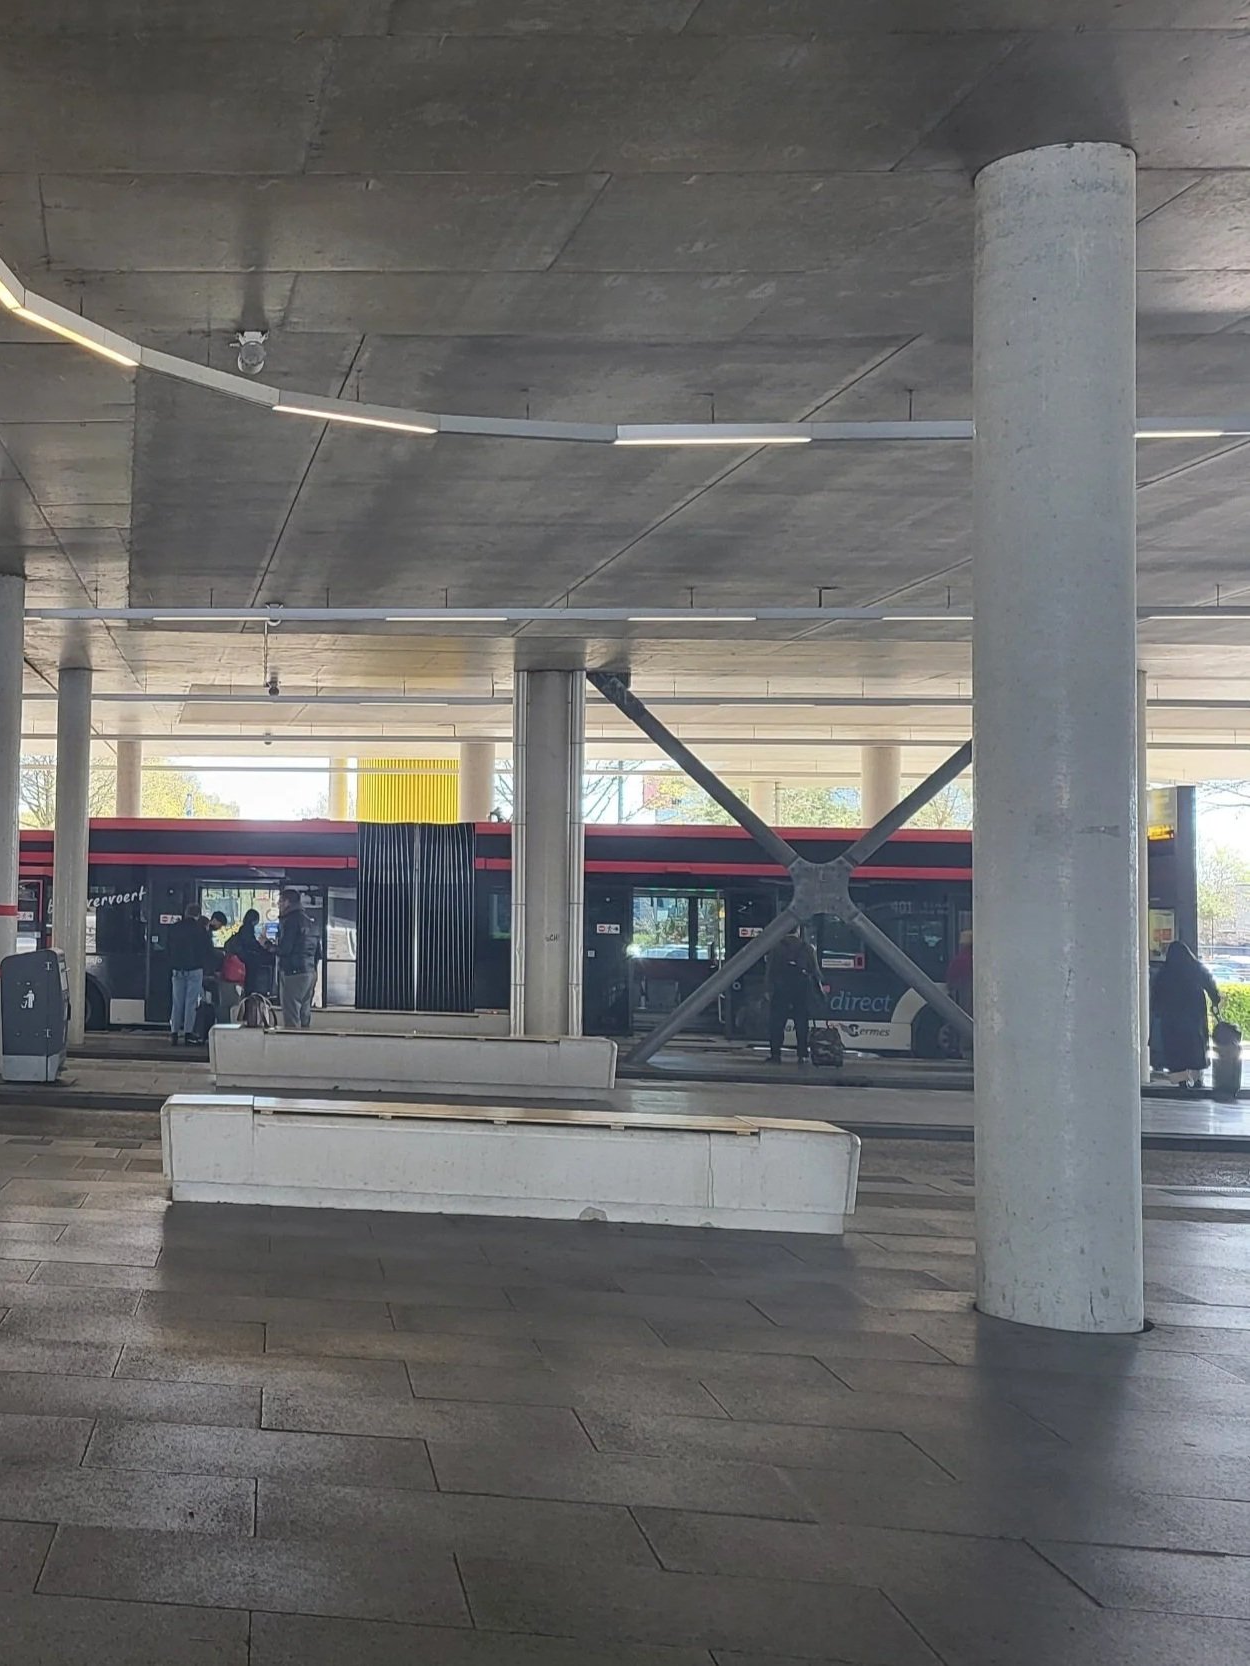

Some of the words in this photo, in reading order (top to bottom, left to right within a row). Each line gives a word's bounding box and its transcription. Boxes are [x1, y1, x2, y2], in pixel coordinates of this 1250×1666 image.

[86, 885, 147, 909] vervoert
[829, 990, 893, 1013] direct
[847, 1023, 891, 1038] Hermes
